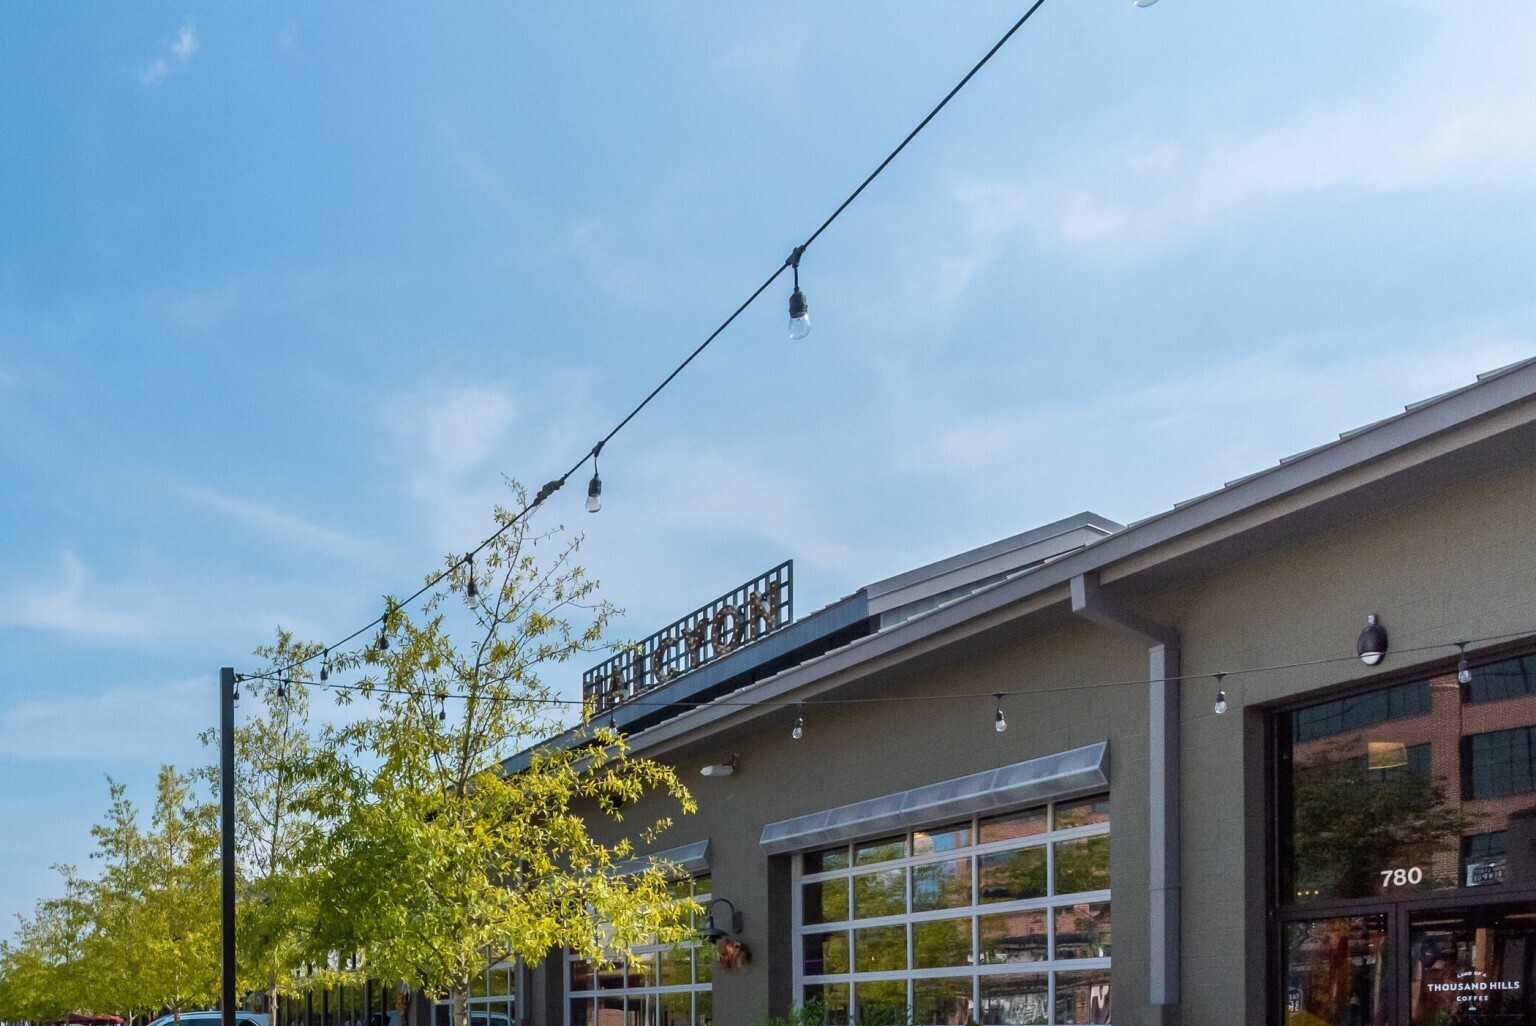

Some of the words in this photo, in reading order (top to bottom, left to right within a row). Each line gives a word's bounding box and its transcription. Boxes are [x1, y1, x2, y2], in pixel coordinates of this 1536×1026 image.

[1380, 866, 1423, 887] 780
[1456, 971, 1472, 979] LAND
[1427, 982, 1488, 992] THOUSAND
[1489, 981, 1520, 990] HILLS
